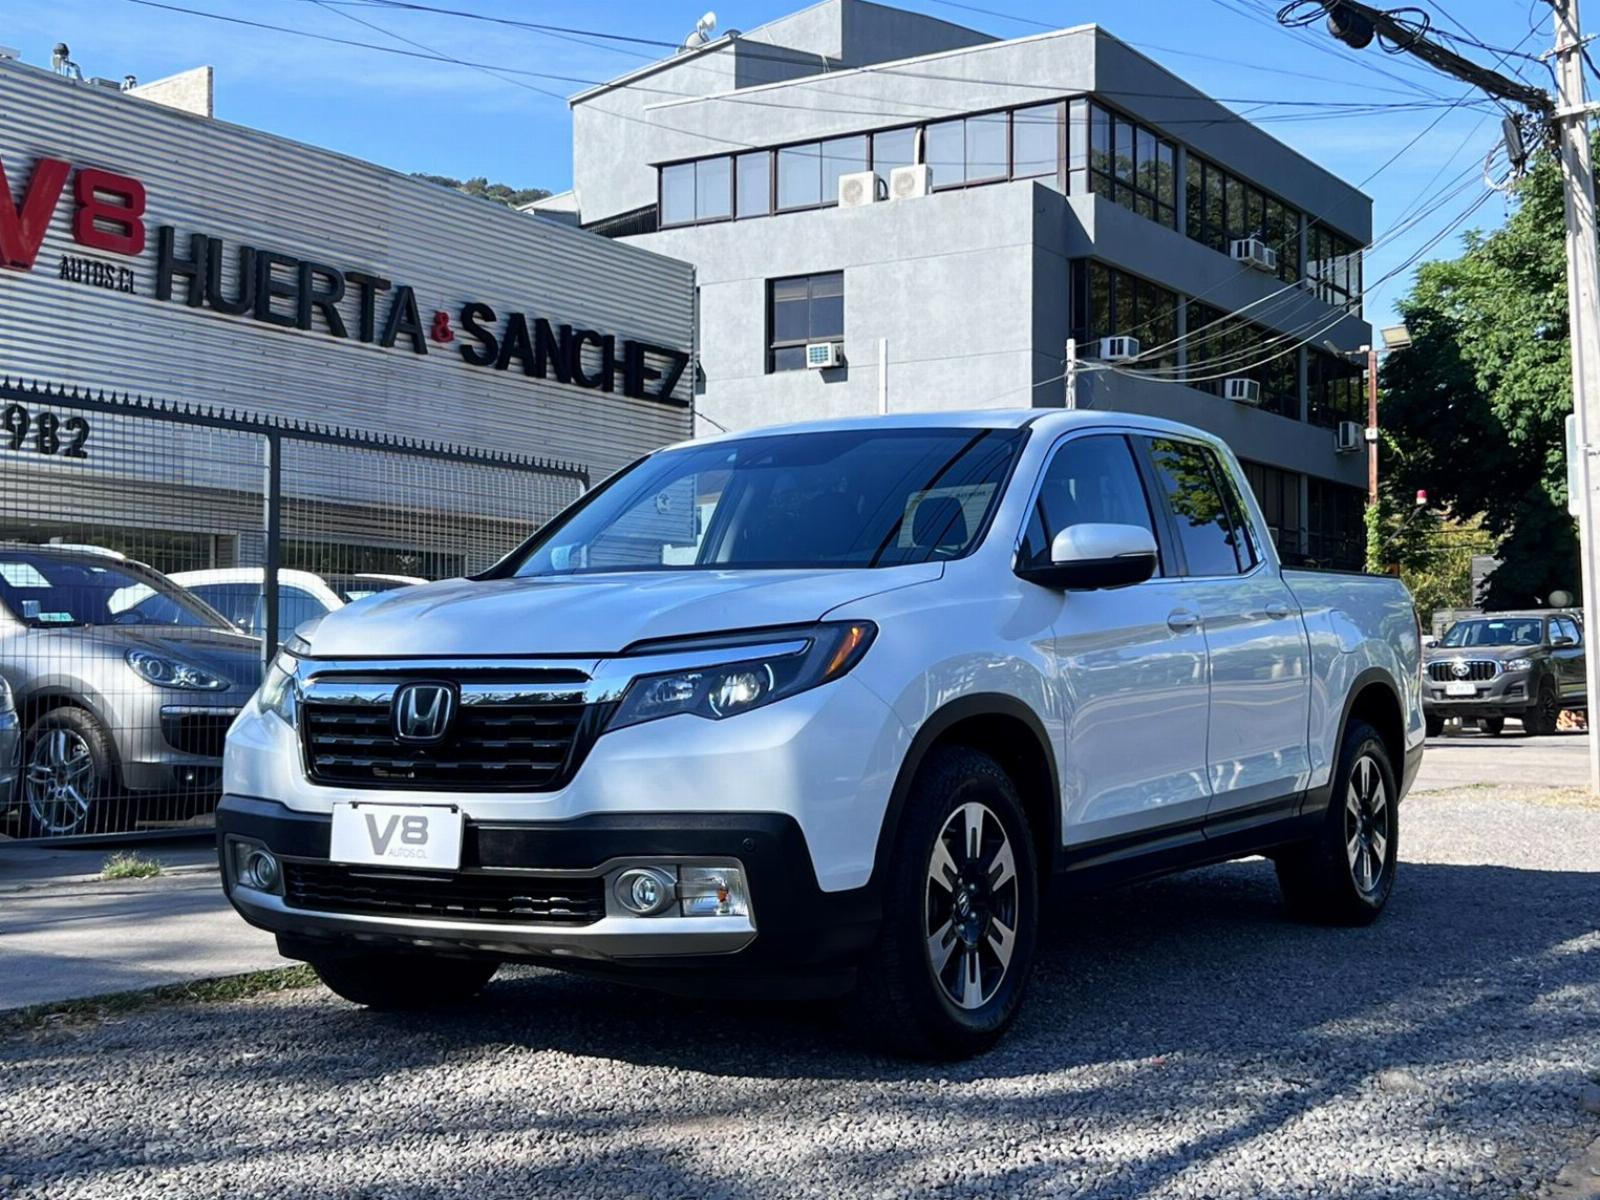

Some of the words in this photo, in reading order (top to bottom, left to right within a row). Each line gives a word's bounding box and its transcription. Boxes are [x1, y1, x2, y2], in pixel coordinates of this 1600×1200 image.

[0, 155, 146, 271] V8
[60, 254, 137, 295] AUTOS.CL
[156, 225, 428, 354] HUERTA
[431, 311, 454, 343] &
[460, 302, 690, 408] SANCHEZ
[365, 813, 428, 855] V8
